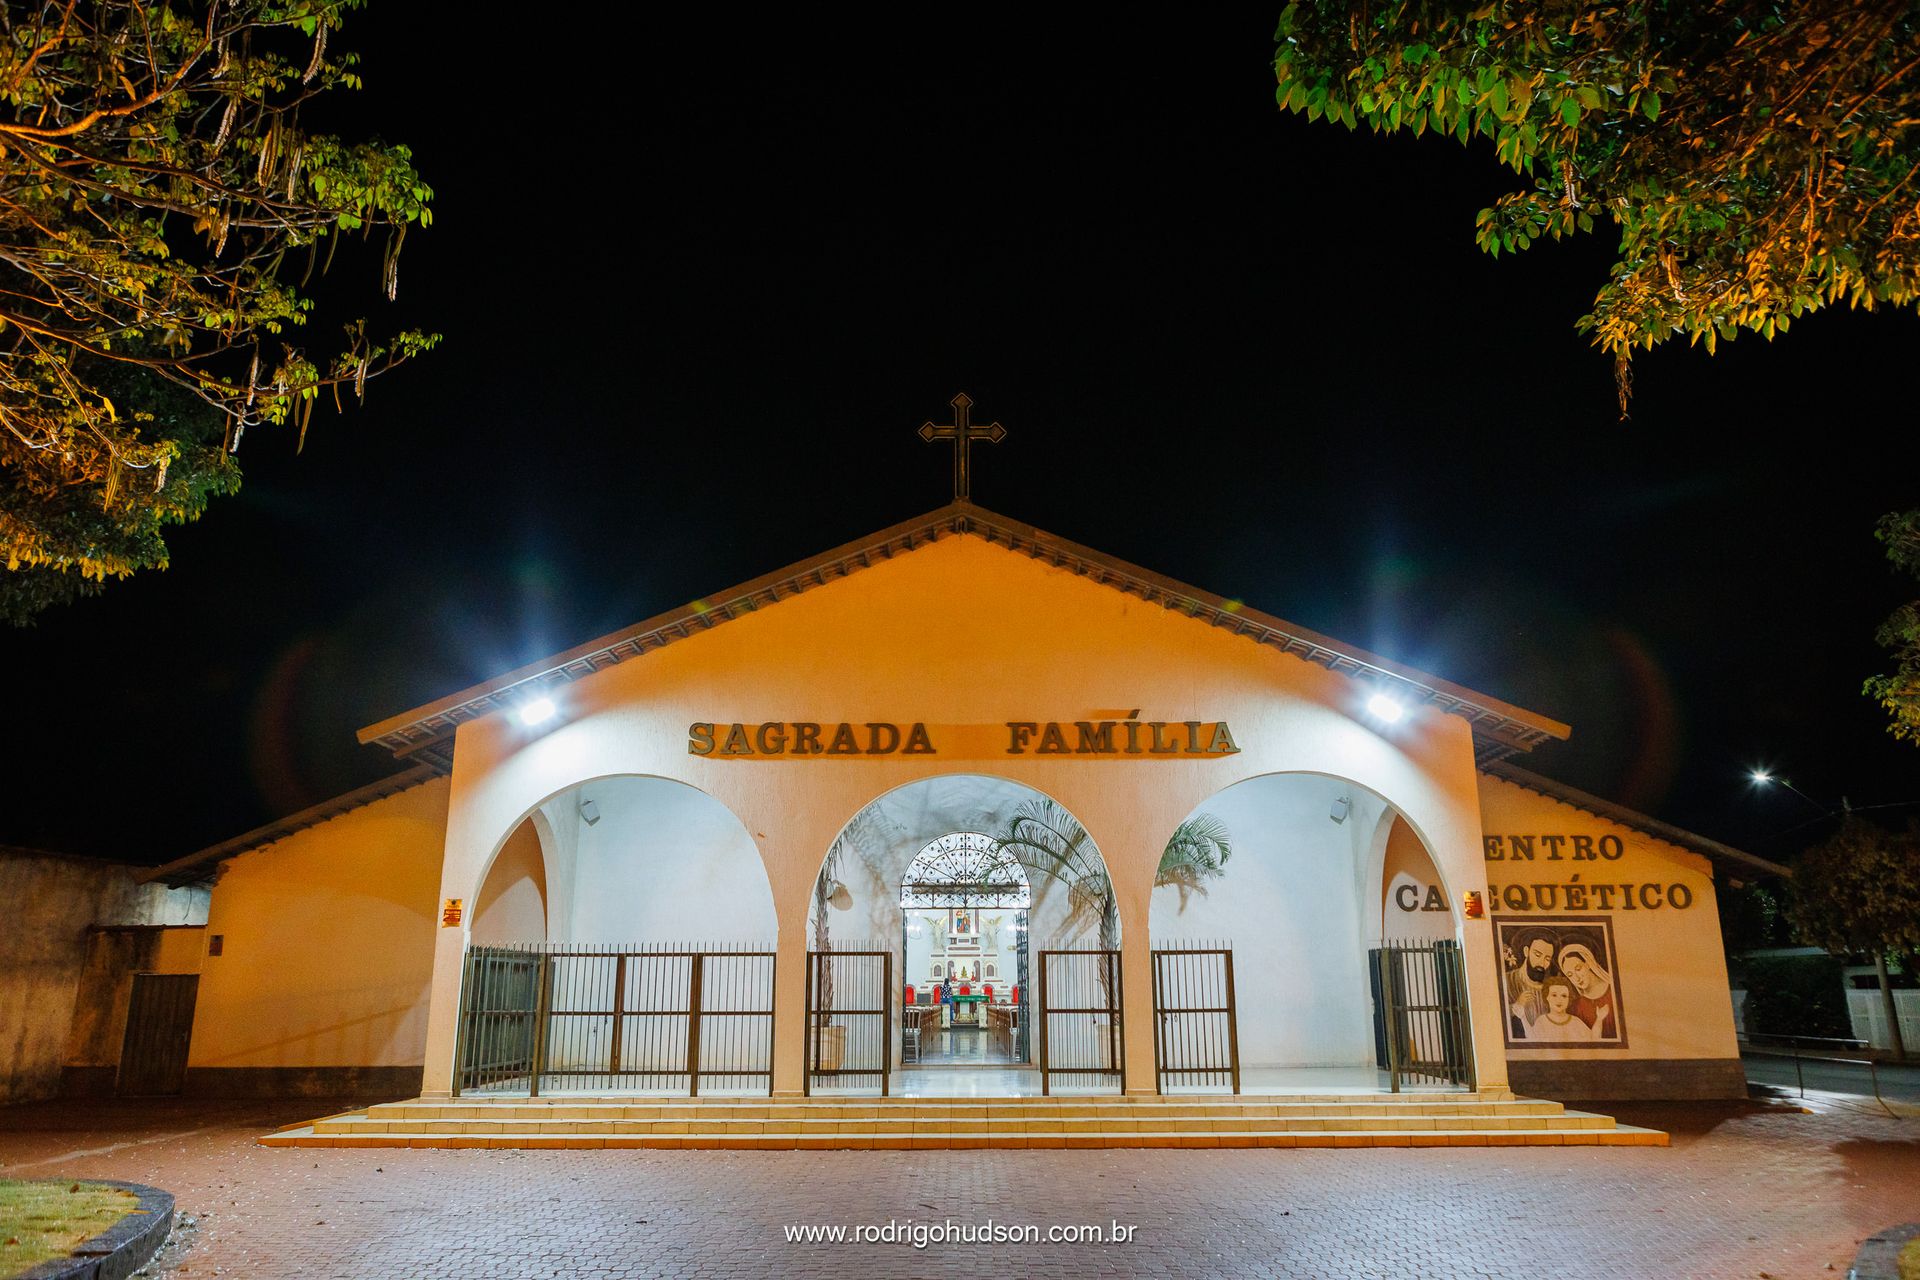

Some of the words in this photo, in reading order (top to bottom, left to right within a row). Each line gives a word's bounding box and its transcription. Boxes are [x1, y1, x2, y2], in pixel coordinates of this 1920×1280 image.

[688, 722, 936, 754] SAGRADA
[1006, 709, 1240, 754] FAMÍLIA
[1483, 834, 1624, 861] ENTRO
